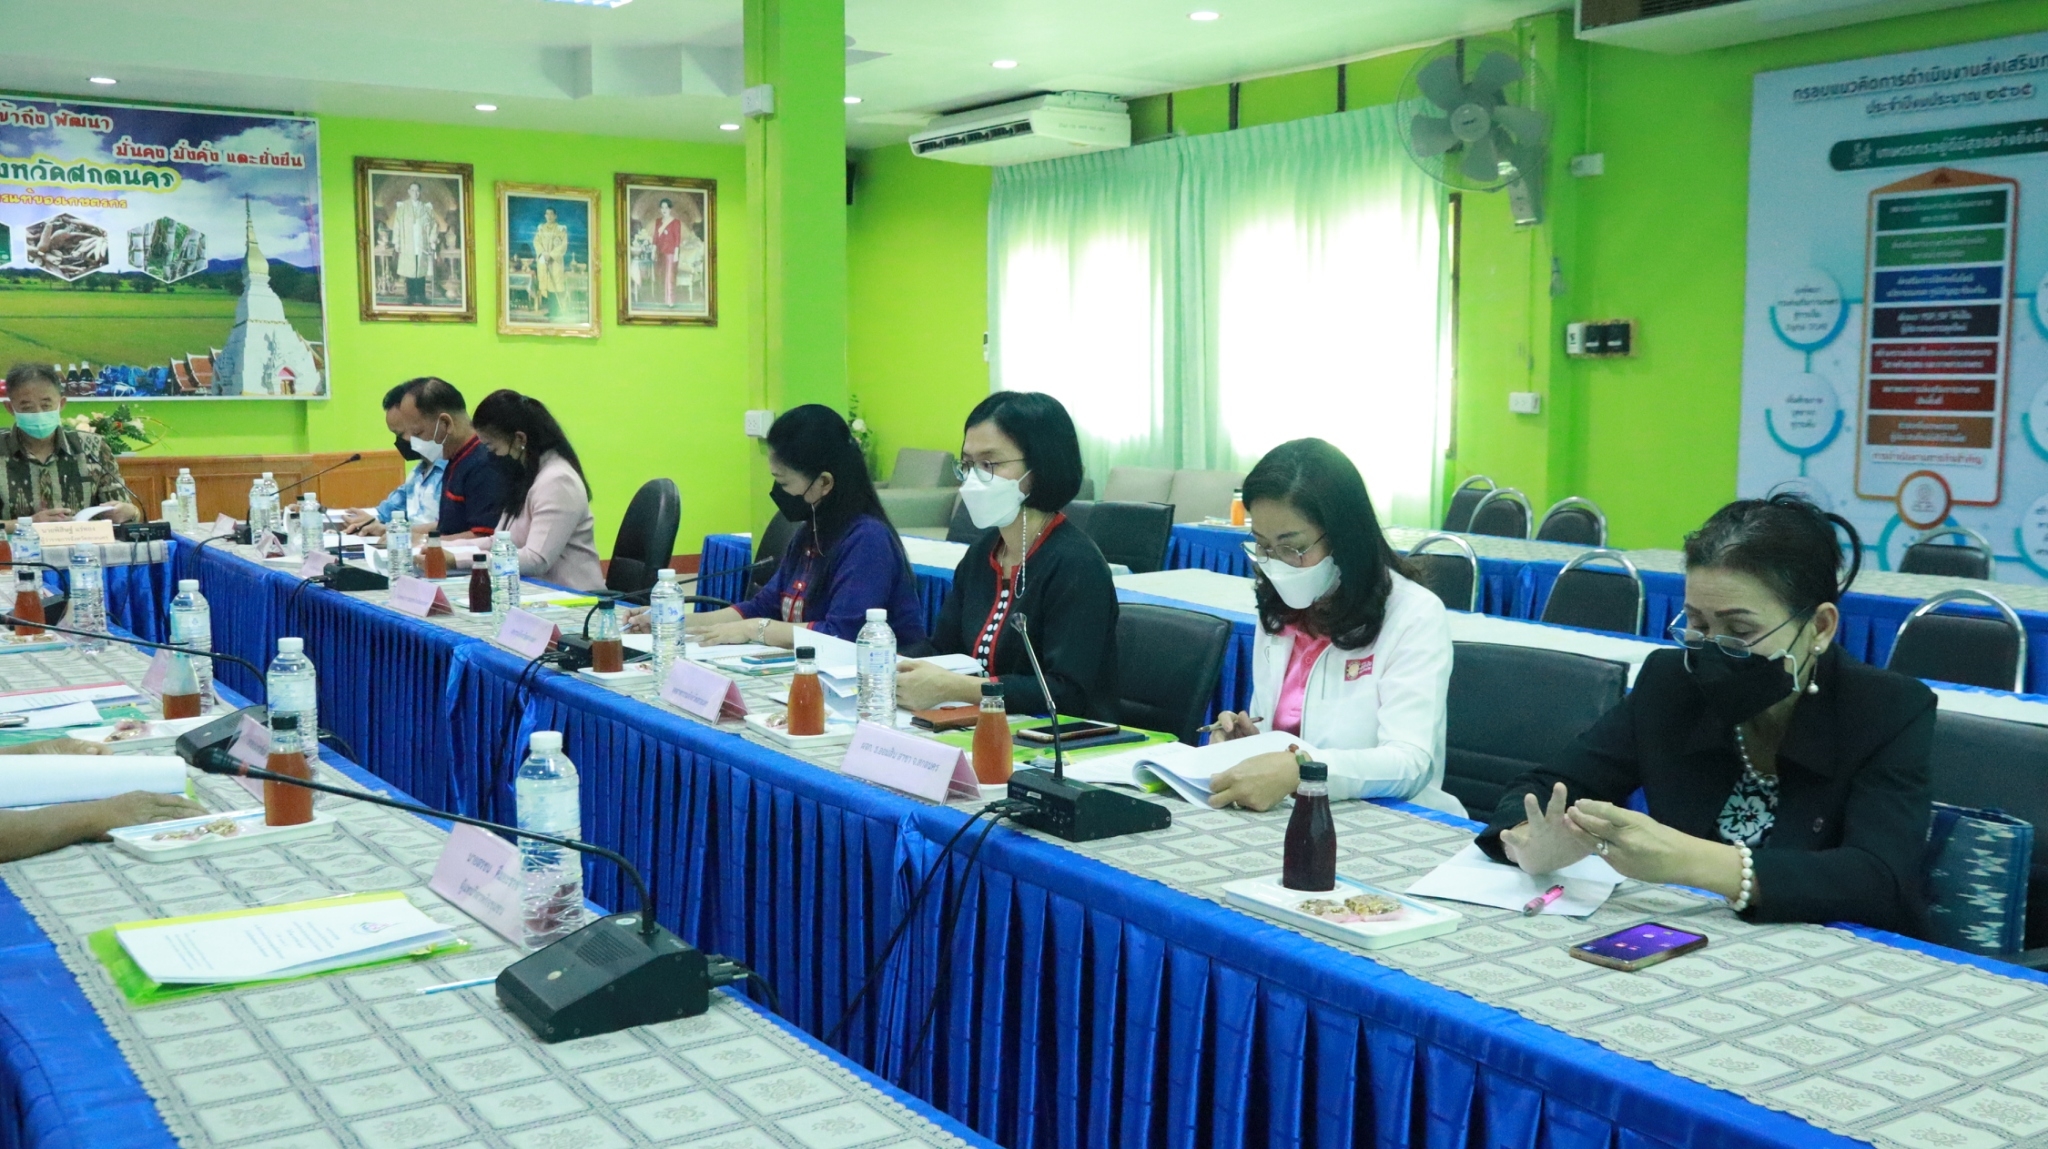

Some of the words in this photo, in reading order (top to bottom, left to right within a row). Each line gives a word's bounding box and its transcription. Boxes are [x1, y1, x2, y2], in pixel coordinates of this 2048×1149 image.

[54, 112, 110, 130] พัฒนา
[116, 138, 165, 159] มั่นคง
[173, 141, 219, 162] มั่งคั่ง
[226, 147, 302, 167] และยั่งยืน
